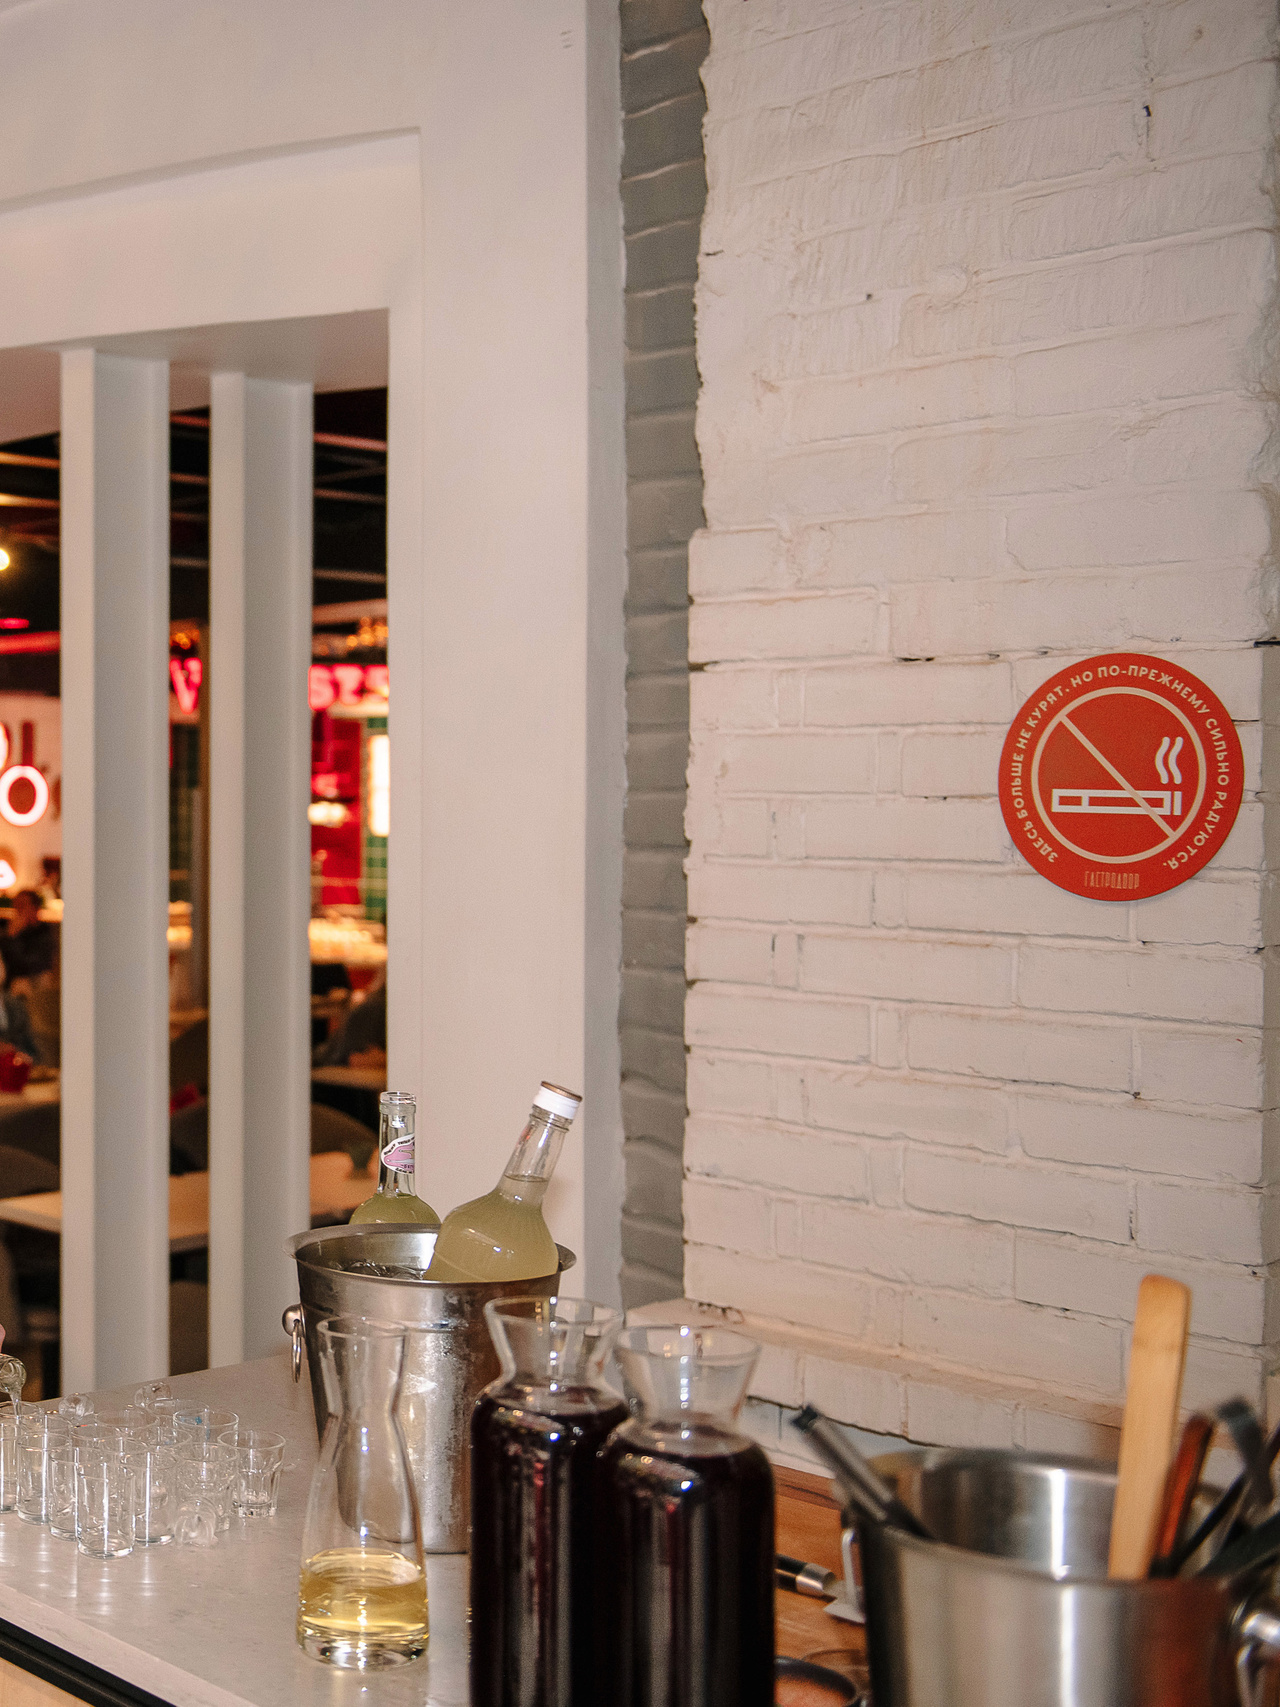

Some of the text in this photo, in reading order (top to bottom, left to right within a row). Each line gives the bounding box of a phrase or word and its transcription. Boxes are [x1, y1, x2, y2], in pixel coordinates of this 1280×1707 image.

[1070, 671, 1094, 688] НО
[1097, 664, 1211, 714] ПО-ПРЕЖНЕМУ
[1016, 728, 1032, 749] НЕ
[1205, 718, 1230, 786] СИЛЬНО
[1011, 752, 1029, 819] БОЛЬШЕ
[1023, 820, 1059, 863] ЗДЕСЬ
[1162, 790, 1228, 870] РАДУЮТСЯ.
